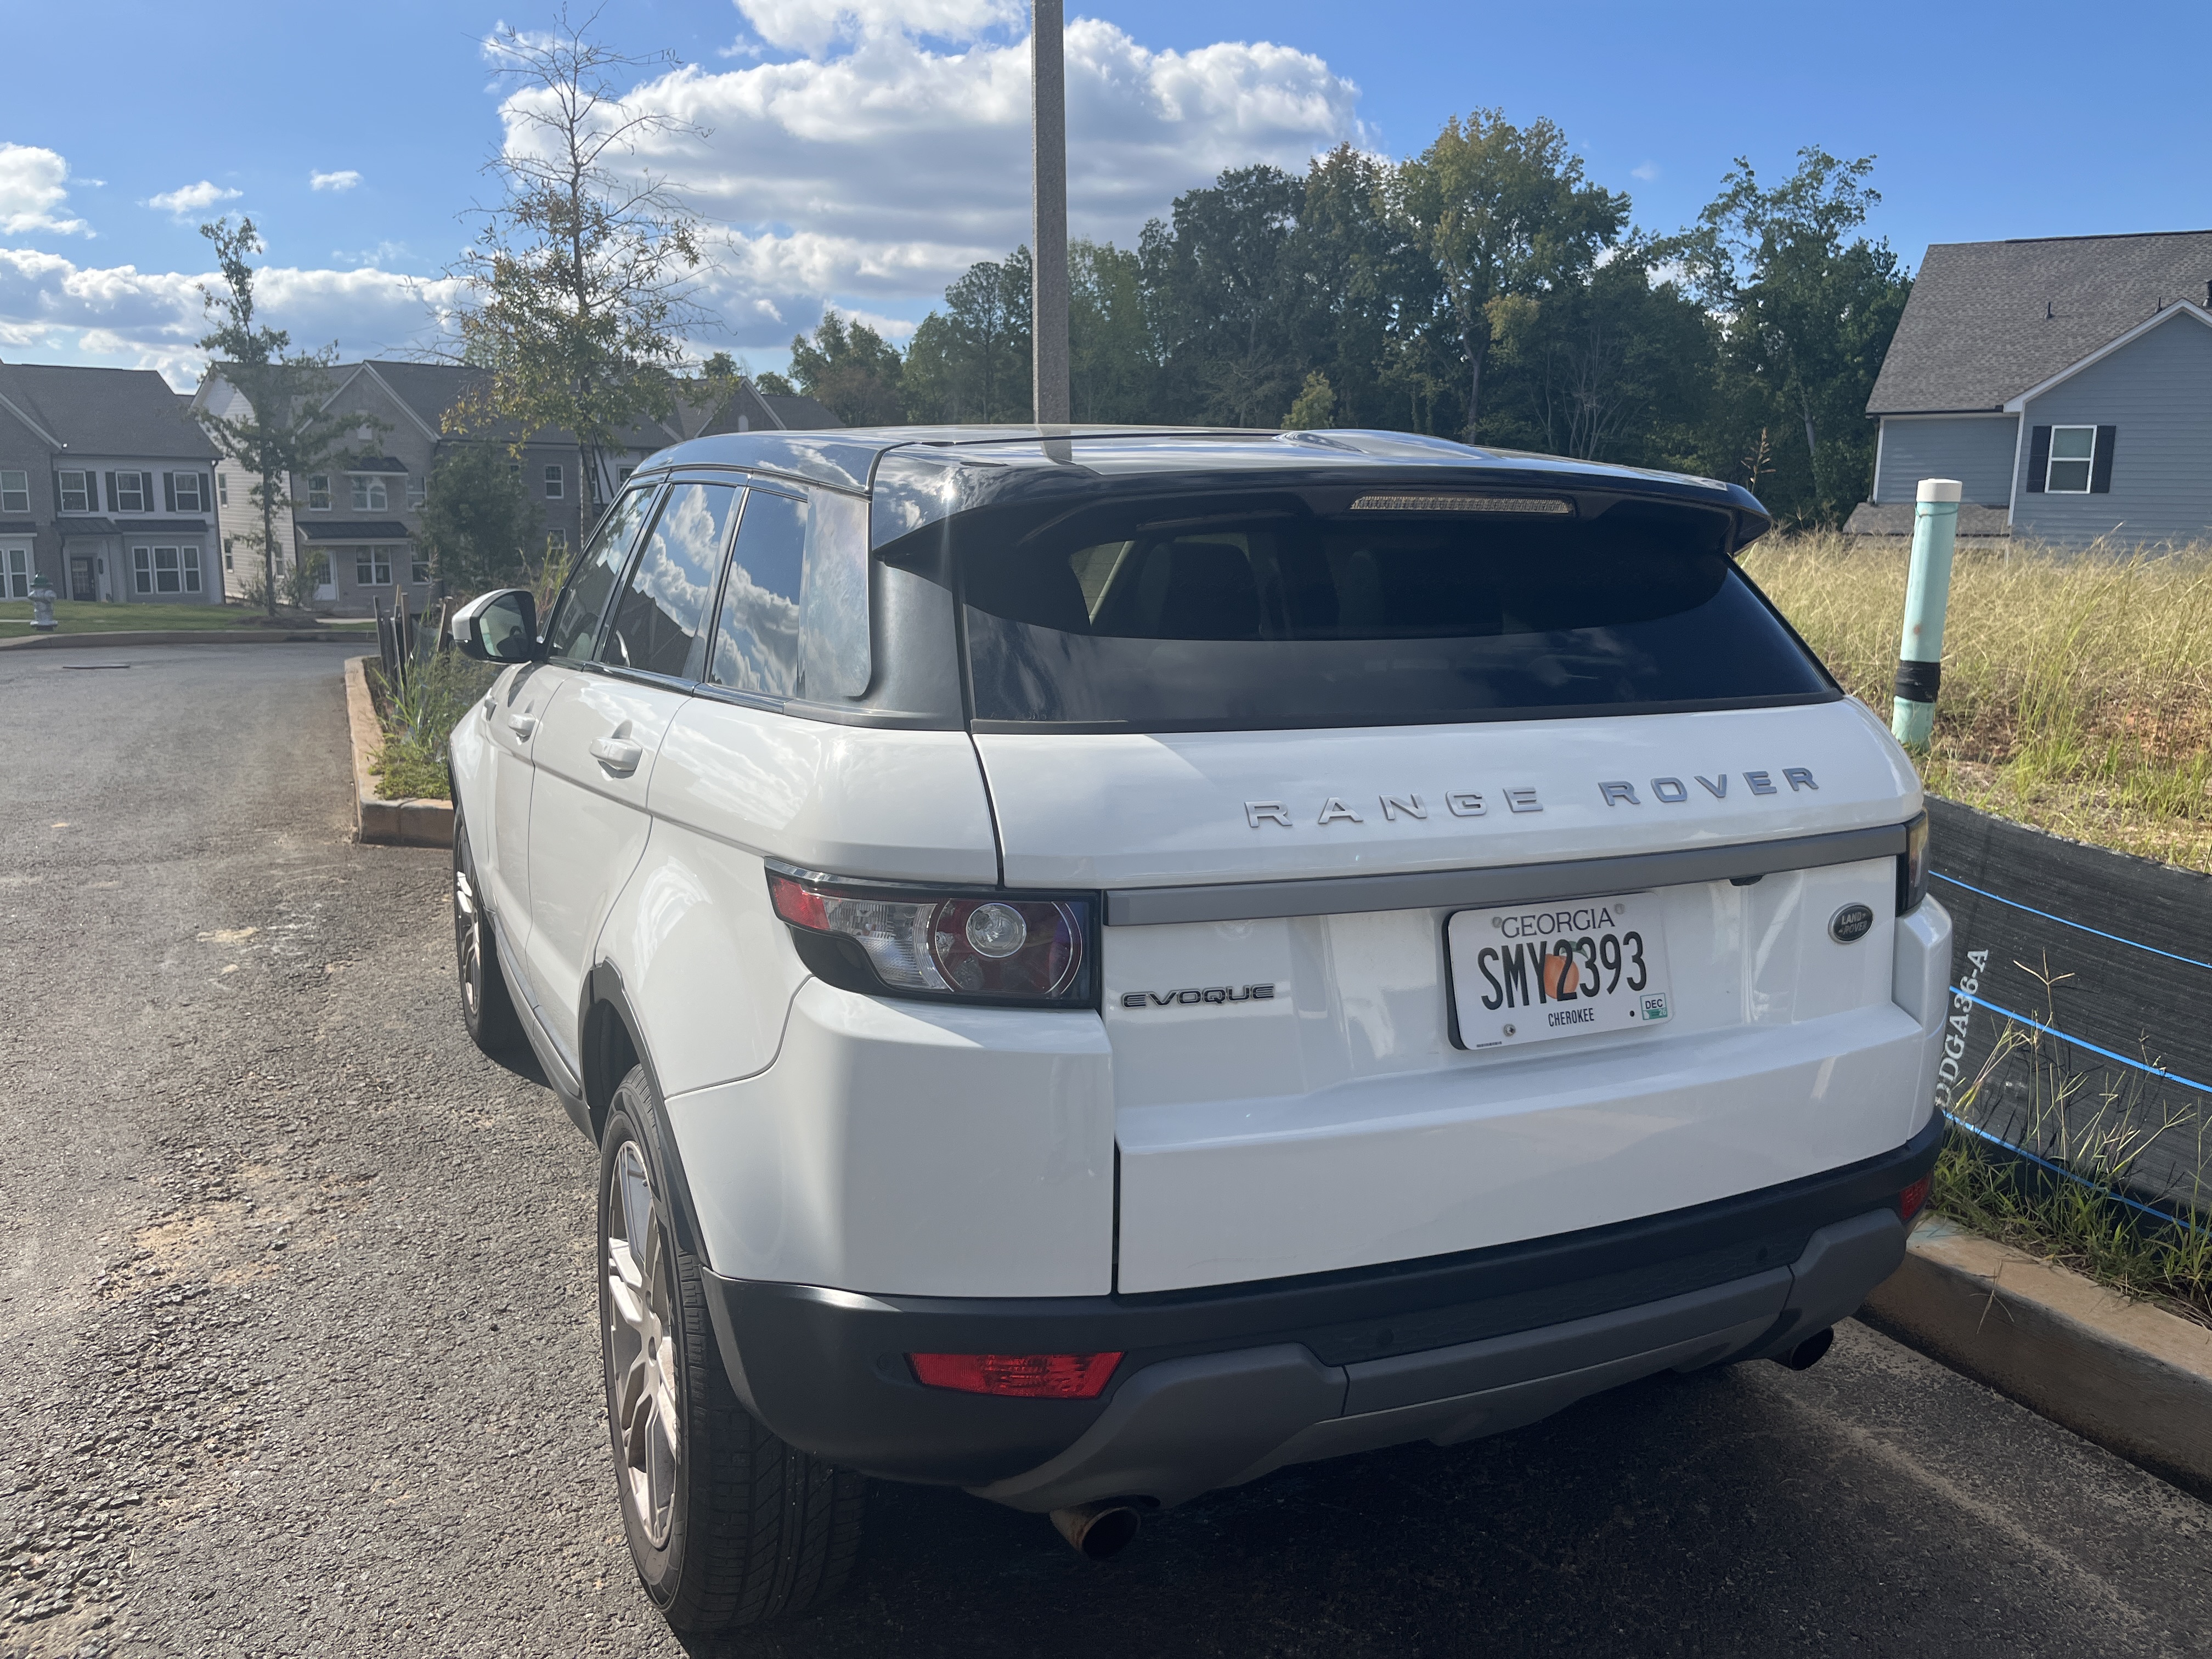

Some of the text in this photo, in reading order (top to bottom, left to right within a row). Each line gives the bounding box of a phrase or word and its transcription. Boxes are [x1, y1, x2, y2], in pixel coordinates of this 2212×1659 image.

[1244, 767, 1820, 828] RANGE ROVER
[1502, 907, 1616, 938] GEORGIA
[1841, 911, 1863, 925] LAND
[1843, 921, 1867, 935] ROVER
[1477, 931, 1647, 1011] SMY2393
[1121, 983, 1274, 1008] EVOQUE
[1645, 998, 1663, 1009] DEC
[1548, 1008, 1595, 1027] CHEROKEE
[1658, 1008, 1667, 1016] 26
